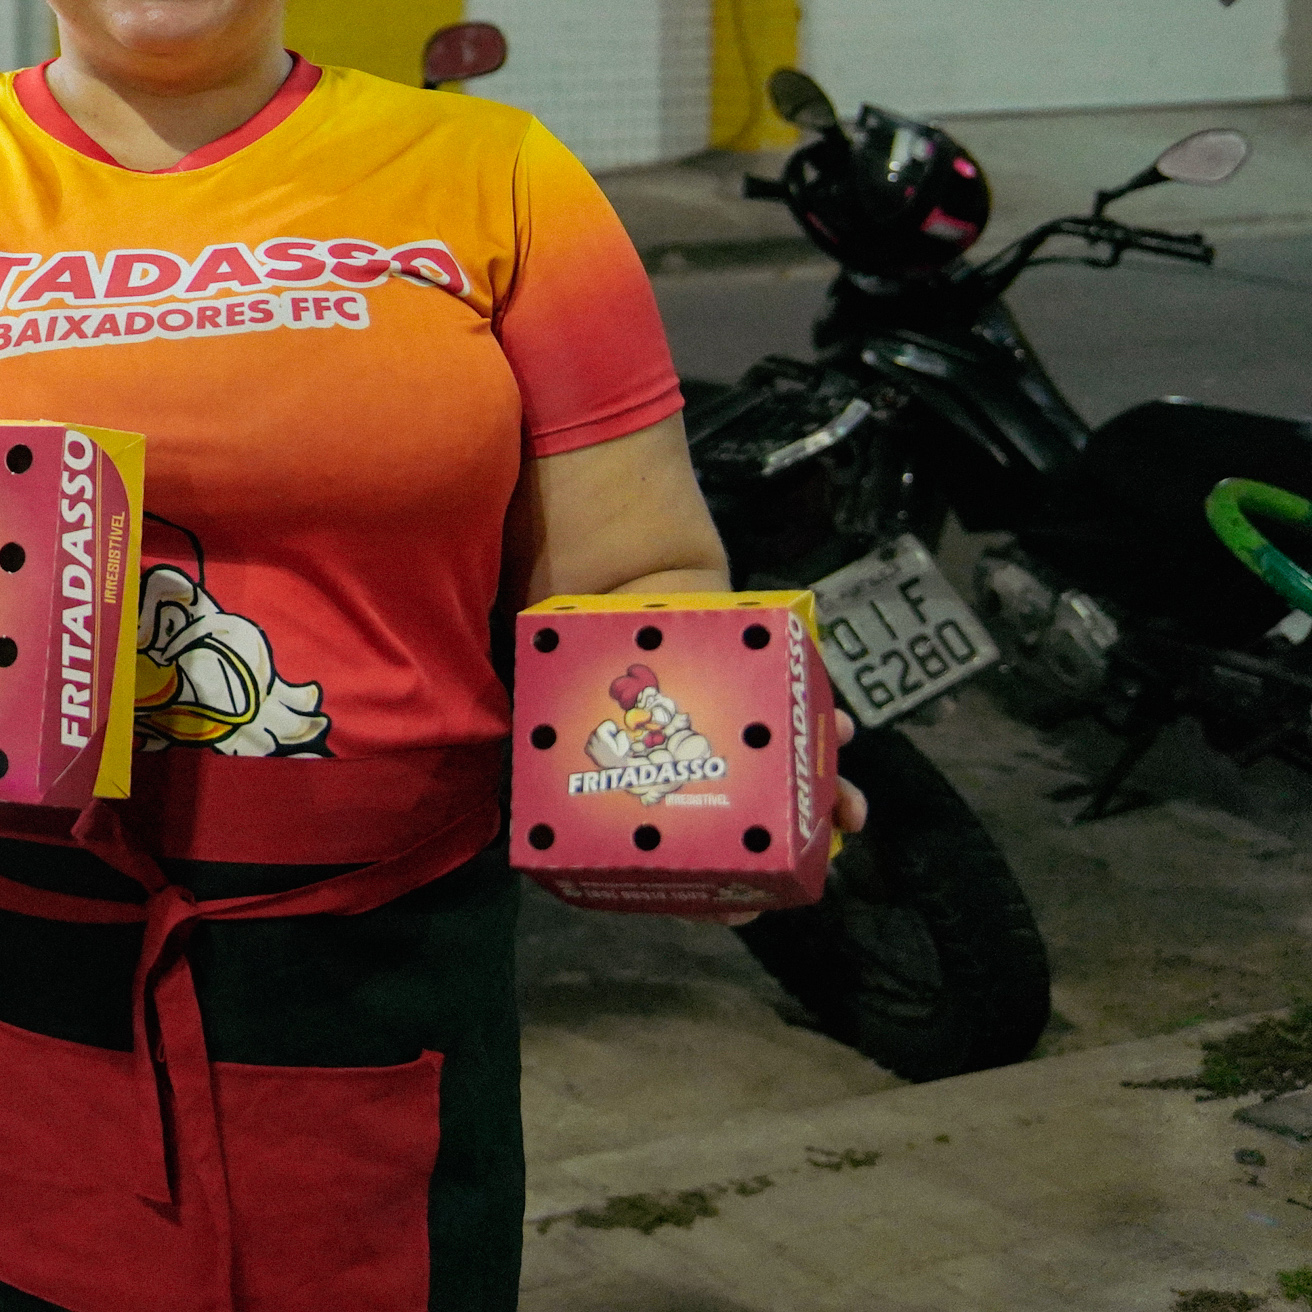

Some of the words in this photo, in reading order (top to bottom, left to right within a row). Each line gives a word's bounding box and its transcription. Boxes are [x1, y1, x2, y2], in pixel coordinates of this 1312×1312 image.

[290, 295, 361, 322] FFC
[60, 429, 95, 749] FRITADASSO
[104, 510, 126, 603] IRRESISTÍVEL
[787, 610, 812, 840] FRITADASSO
[568, 756, 727, 796] FRITADASSO
